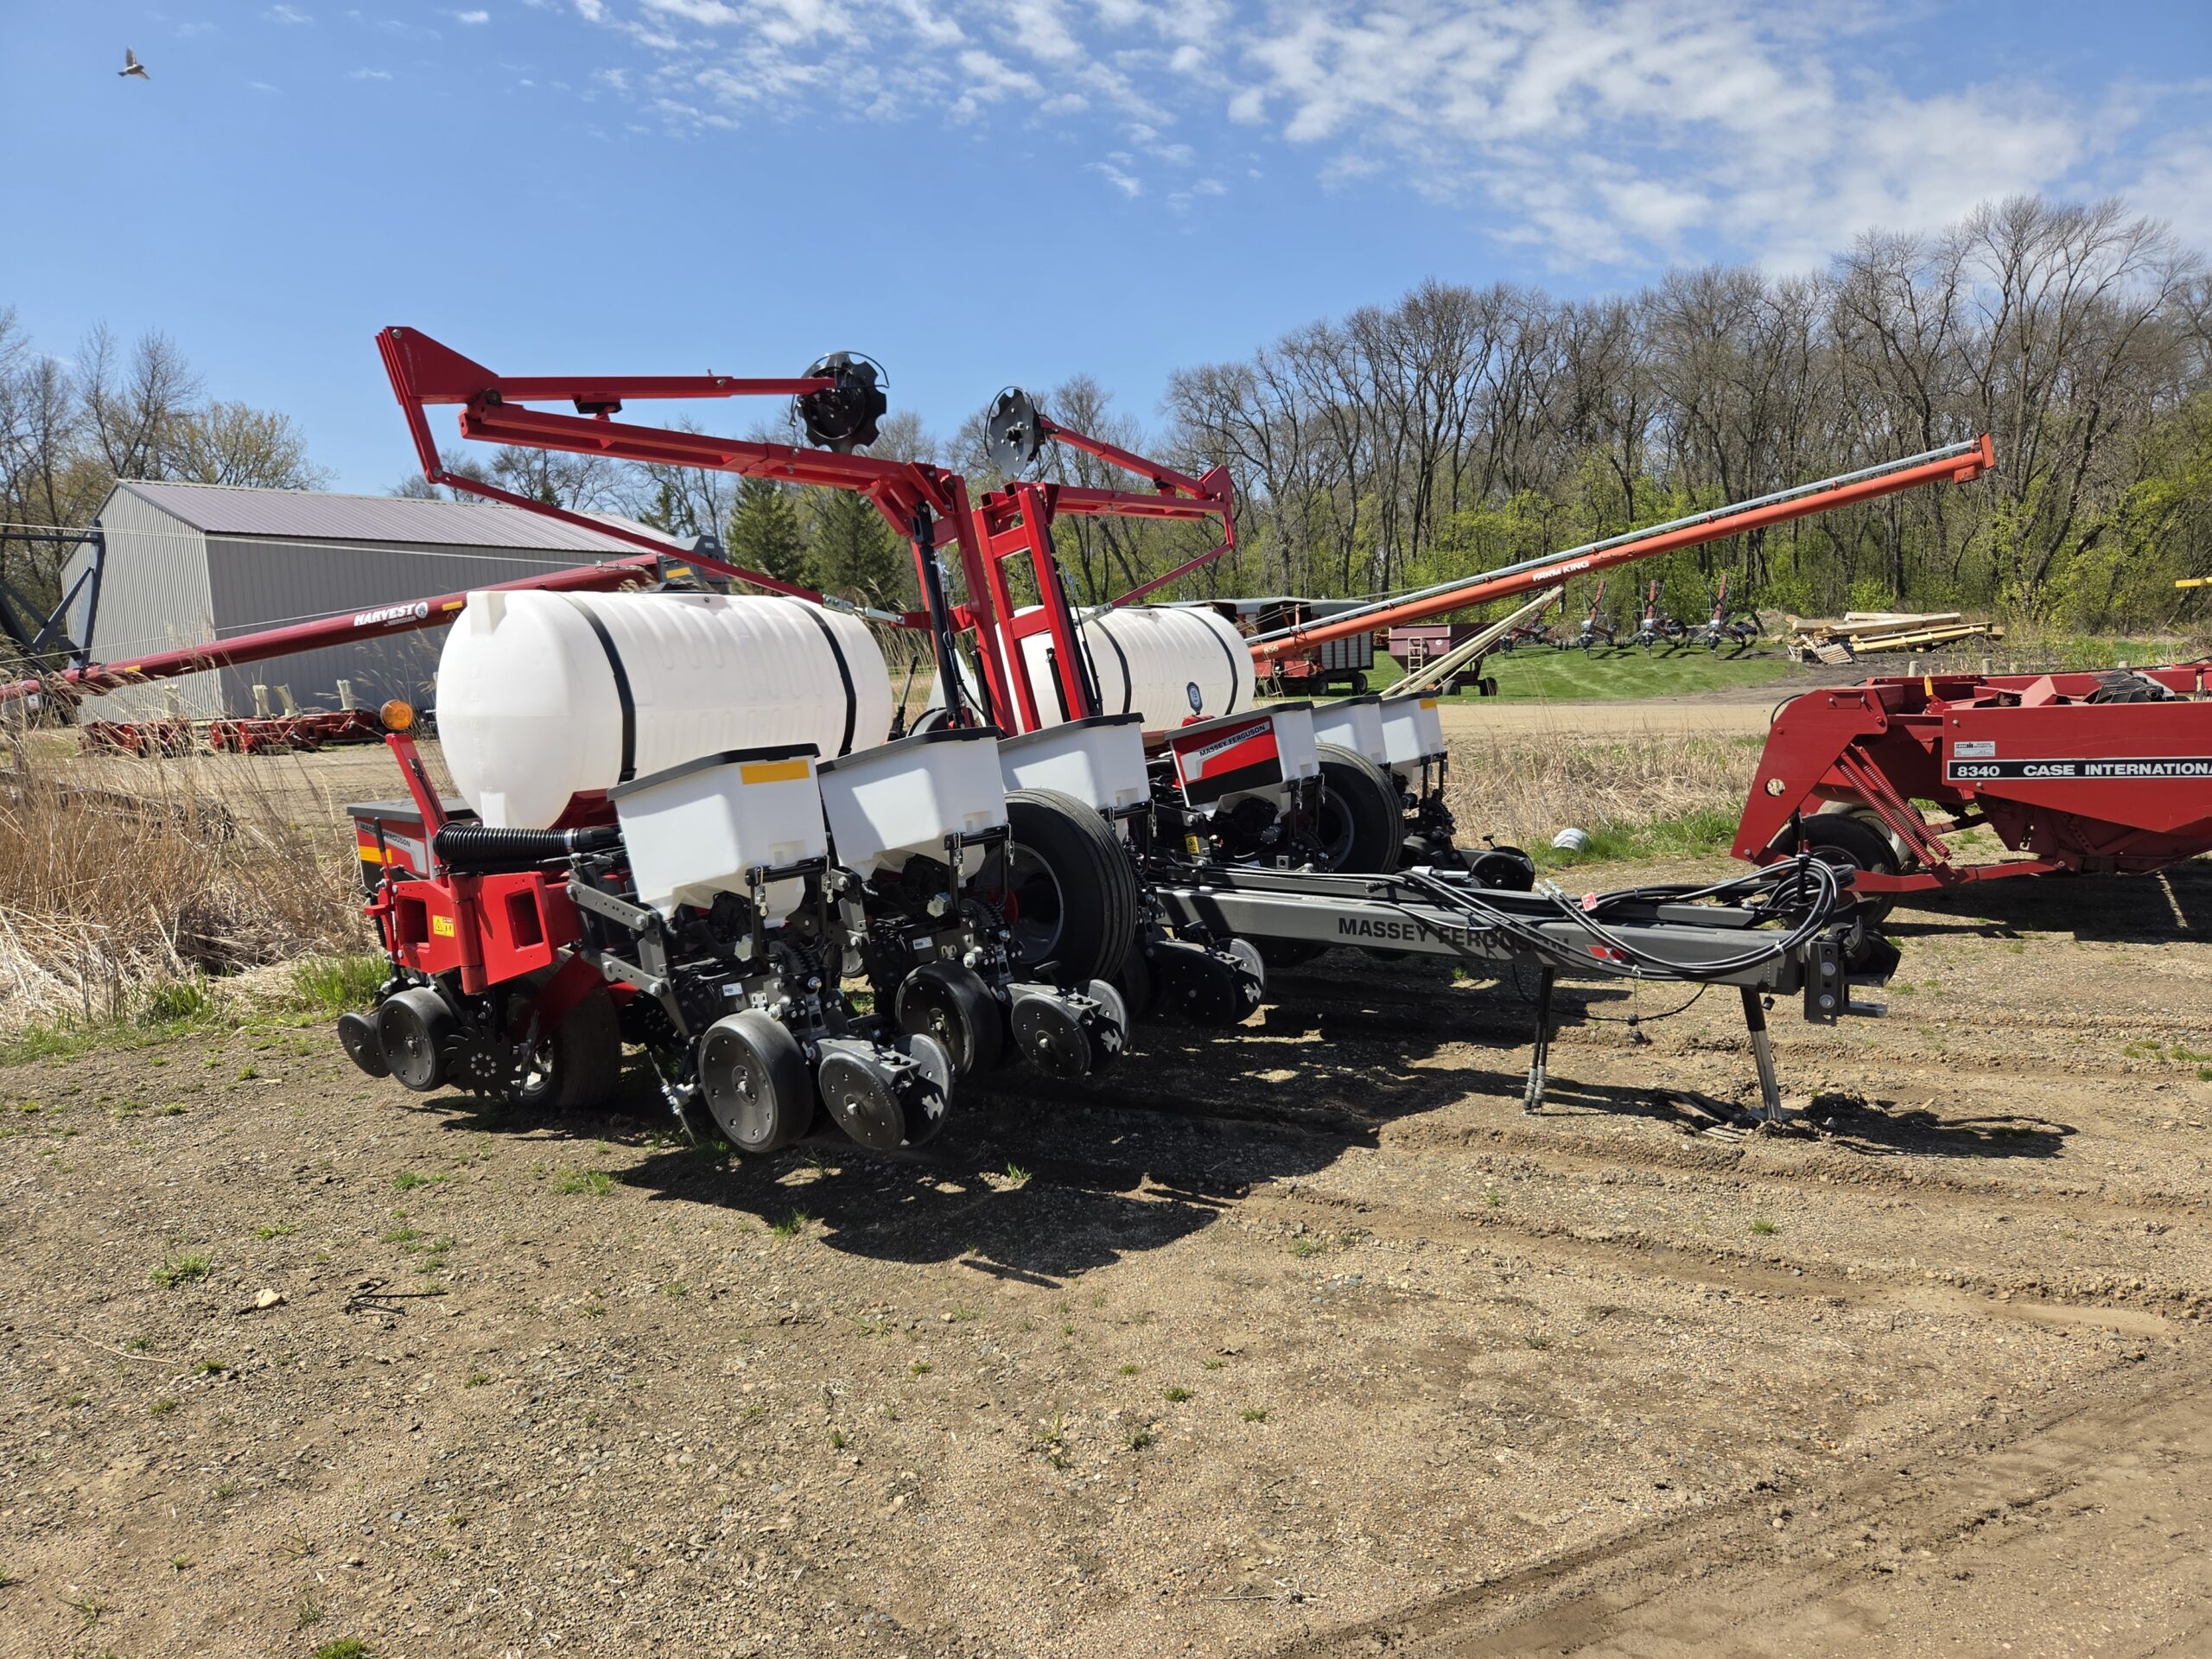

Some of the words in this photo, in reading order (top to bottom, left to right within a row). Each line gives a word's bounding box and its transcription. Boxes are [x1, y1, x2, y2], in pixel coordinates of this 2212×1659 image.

[1532, 568, 1562, 582] FARM
[1562, 560, 1590, 574] KING
[353, 604, 416, 626] HARVEST
[1263, 644, 1279, 654] 856
[1198, 741, 1228, 757] MASSEY
[1228, 725, 1266, 745] FERGUSON
[1956, 765, 2000, 777] 8340
[2023, 764, 2075, 776] CASE
[2084, 762, 2212, 776] INTERNATION
[1338, 917, 1427, 943] MASSEY
